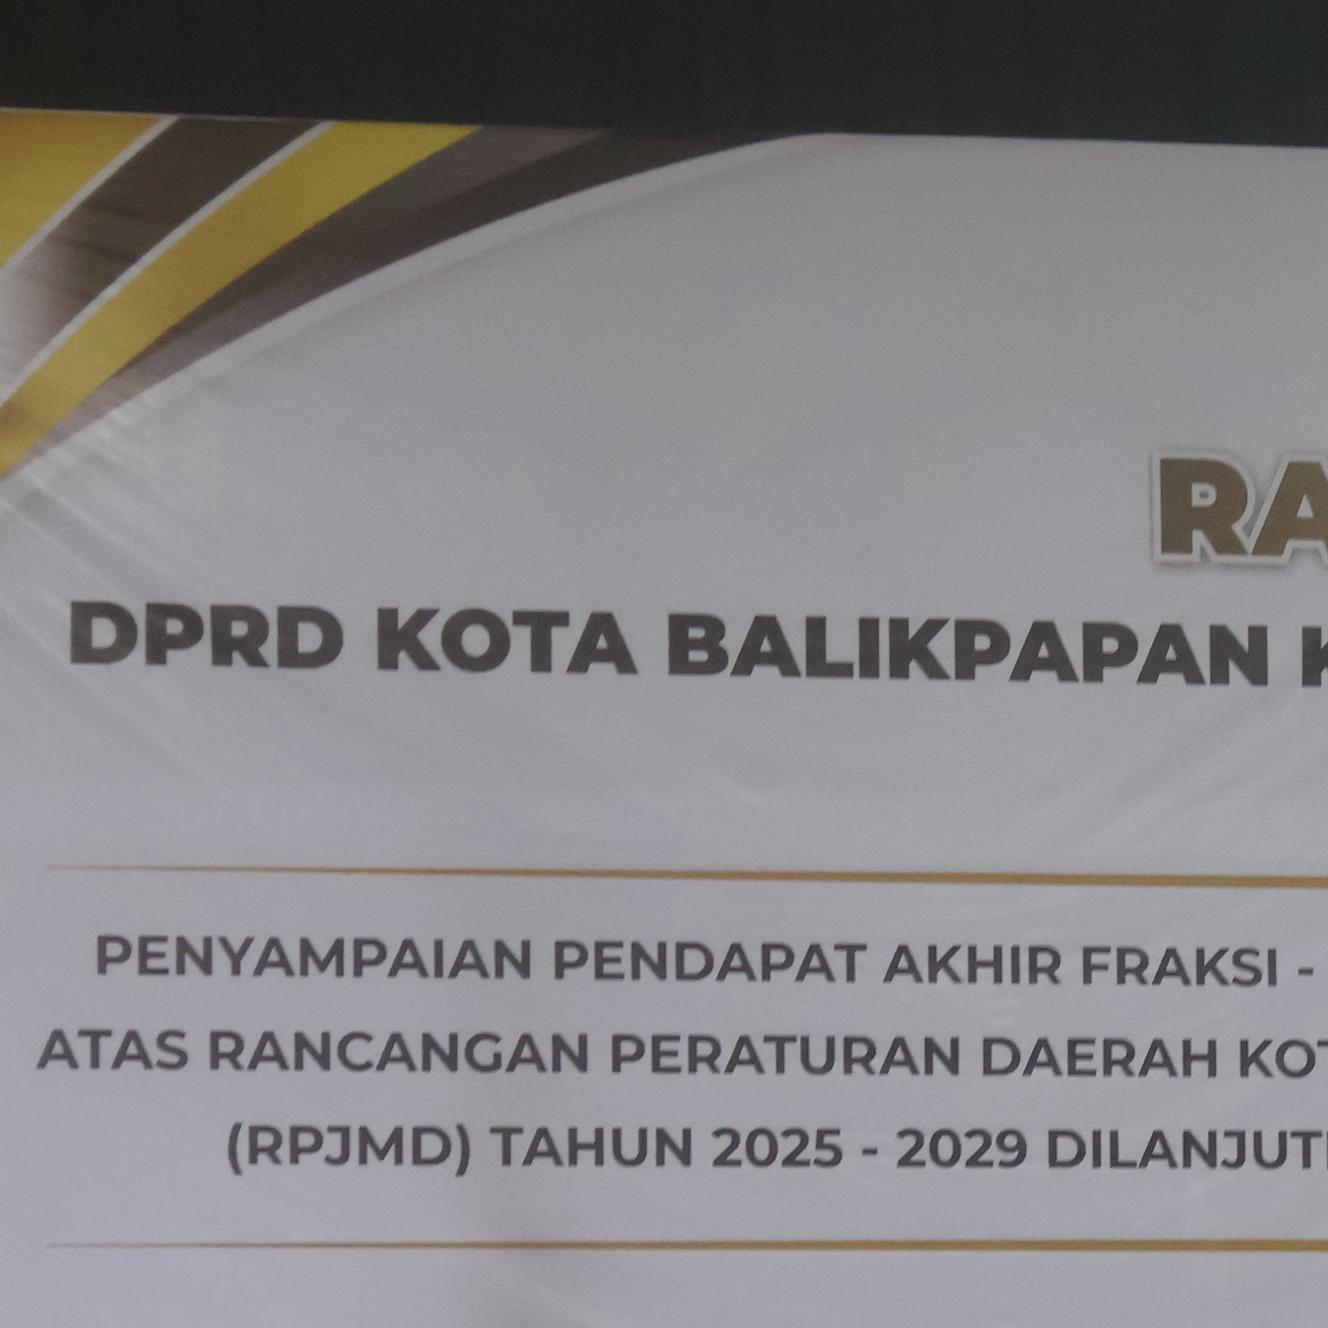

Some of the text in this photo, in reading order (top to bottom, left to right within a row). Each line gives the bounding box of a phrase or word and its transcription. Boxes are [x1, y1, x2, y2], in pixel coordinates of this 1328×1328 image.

[69, 599, 345, 671] DPRD
[376, 606, 639, 676] KOTA
[667, 611, 1269, 688] BALIKPAPAN
[96, 933, 532, 981] PENYAMPAIAN
[553, 938, 869, 984] PENDAPAT
[882, 942, 1062, 986] AKHIR
[1081, 945, 1278, 989] FRAKSI
[1297, 966, 1315, 977] -
[35, 1027, 190, 1072] ATAS
[208, 1029, 589, 1075] RANCANGAN
[611, 1032, 960, 1078] PERATURAN
[981, 1035, 1218, 1080] DAERAH
[227, 1121, 471, 1178] (RPJMD)
[488, 1125, 693, 1169] TAHUN
[710, 1125, 844, 1170] 2025
[861, 1146, 879, 1157] -
[895, 1126, 1028, 1170] 2029
